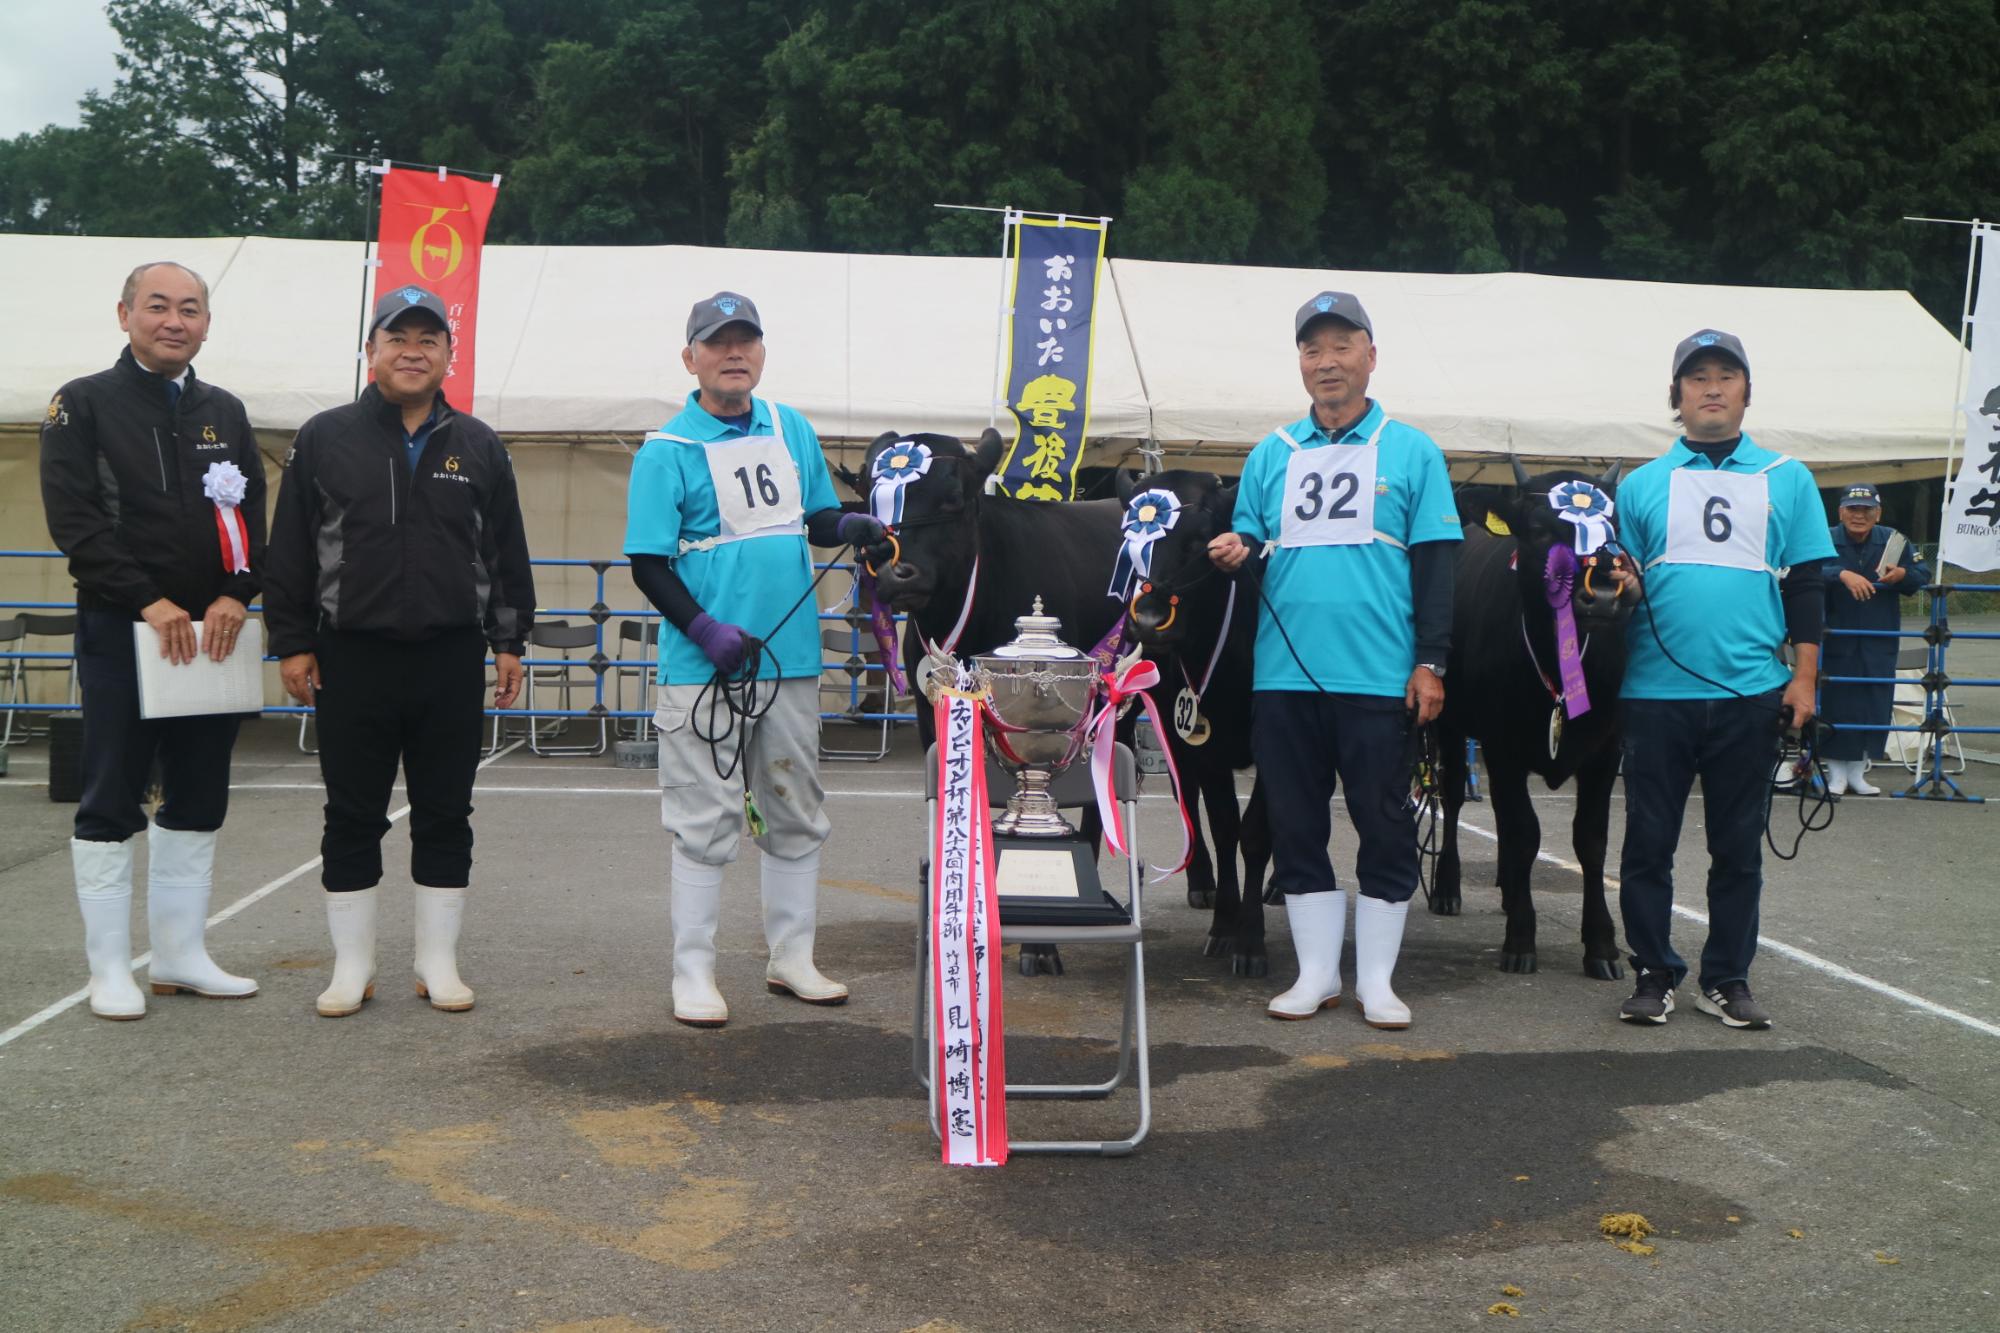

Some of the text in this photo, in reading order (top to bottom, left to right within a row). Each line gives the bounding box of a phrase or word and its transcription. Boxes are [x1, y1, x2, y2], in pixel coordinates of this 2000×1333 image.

[734, 463, 780, 508] 16
[1295, 472, 1360, 521] 32
[1703, 495, 1732, 543] 6
[1176, 696, 1194, 731] 32
